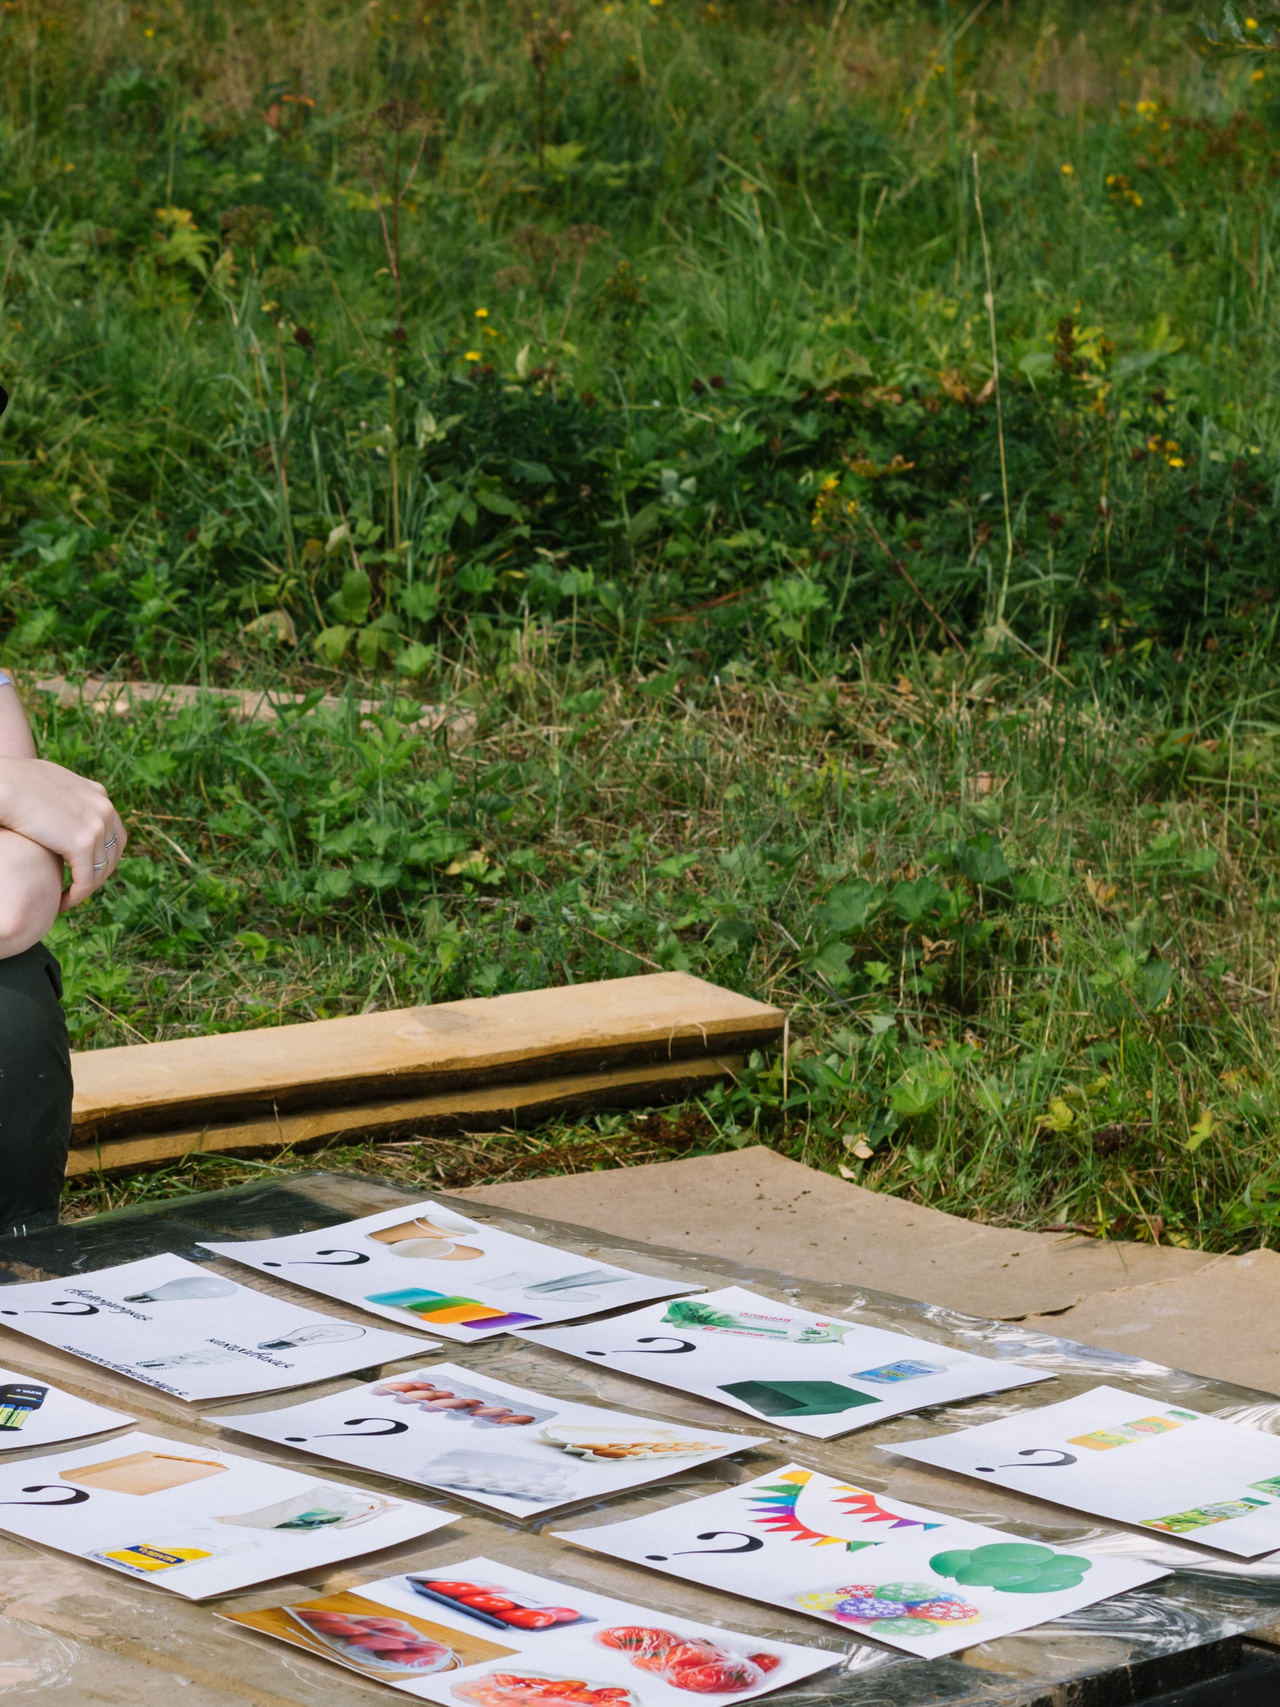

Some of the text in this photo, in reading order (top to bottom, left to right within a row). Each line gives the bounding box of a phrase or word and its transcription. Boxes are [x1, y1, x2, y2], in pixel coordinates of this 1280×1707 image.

[262, 1249, 371, 1268] ?
[1, 1300, 100, 1316] ?
[205, 1338, 295, 1369] накаливания
[586, 1336, 697, 1357] ?
[22, 1388, 43, 1396] VARTA
[284, 1417, 410, 1443] ?
[974, 1448, 1078, 1473] ?
[644, 1531, 764, 1562] ?
